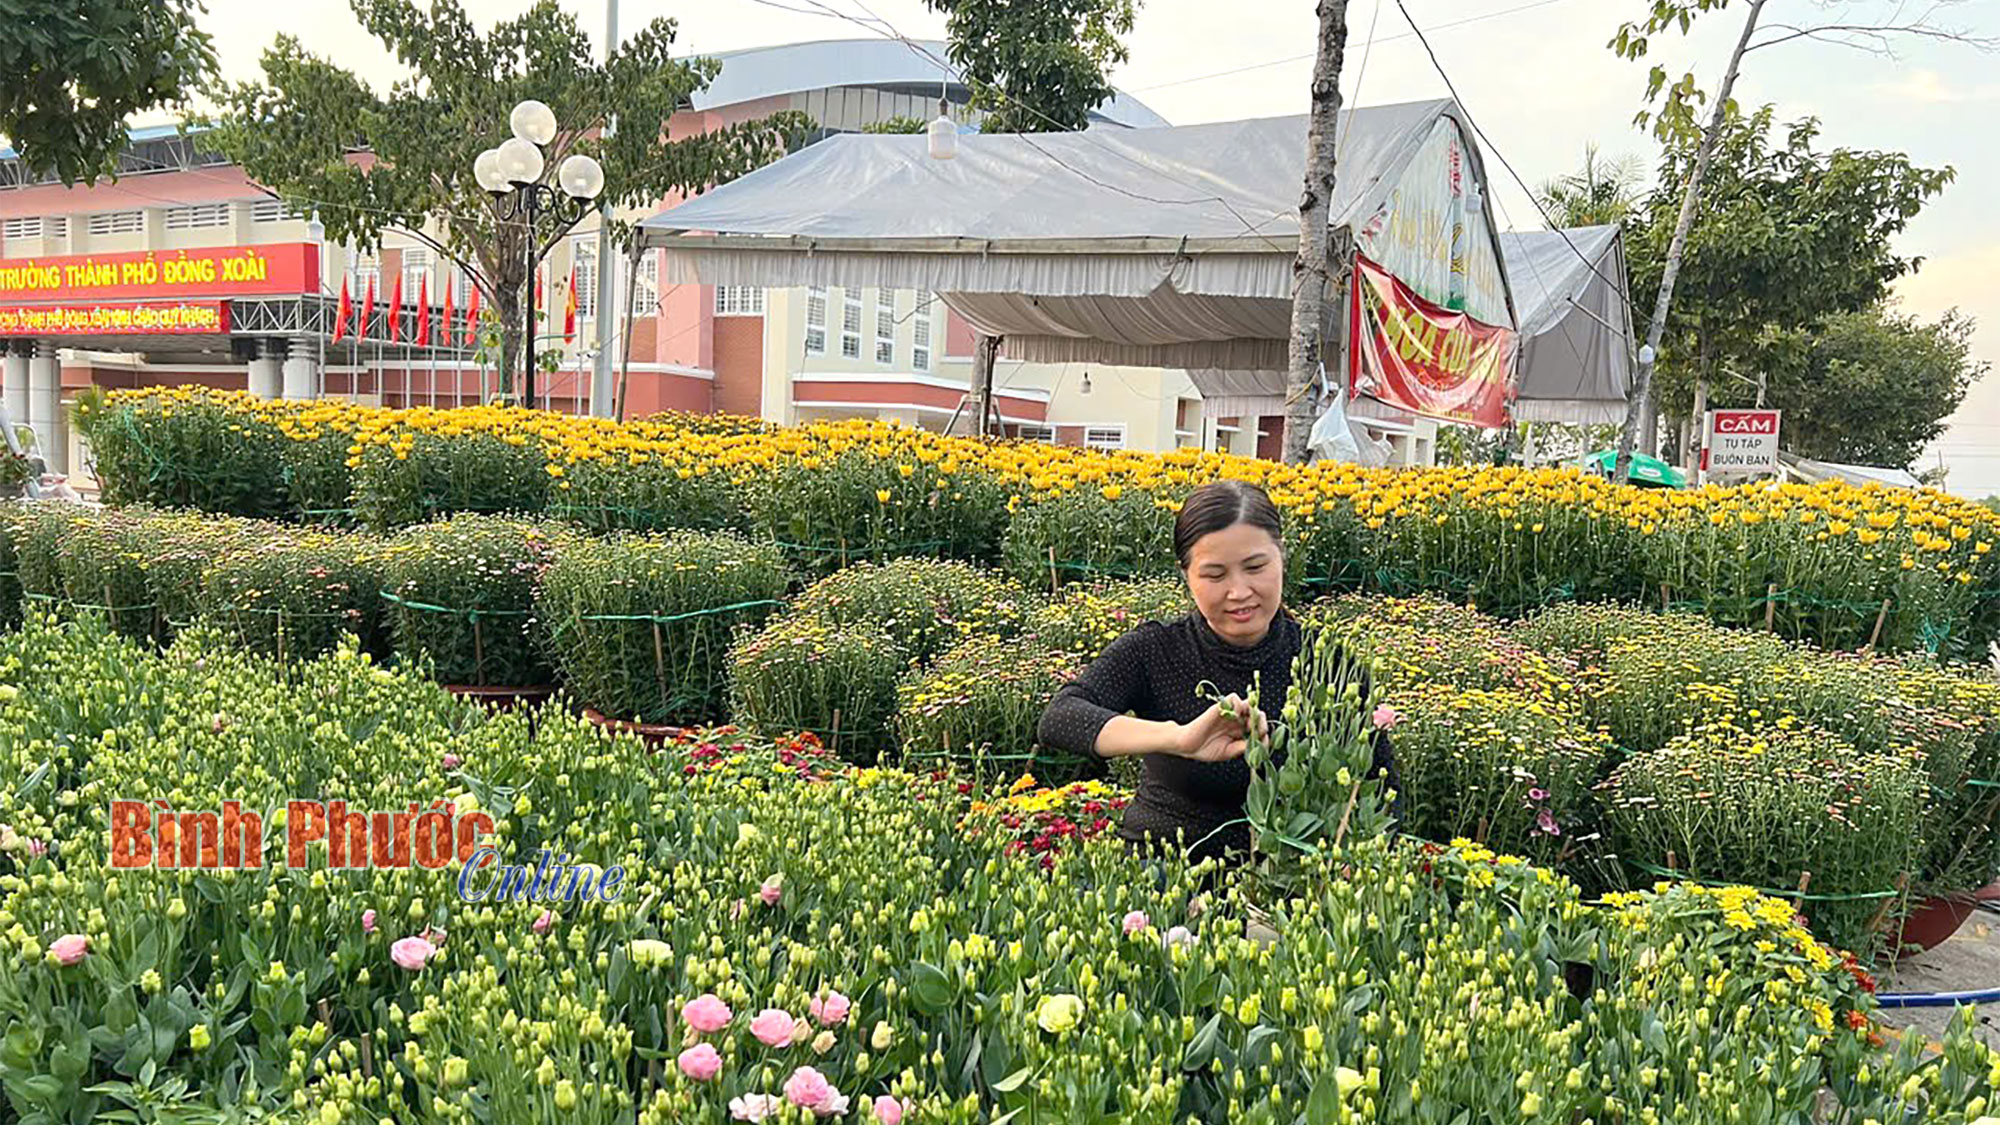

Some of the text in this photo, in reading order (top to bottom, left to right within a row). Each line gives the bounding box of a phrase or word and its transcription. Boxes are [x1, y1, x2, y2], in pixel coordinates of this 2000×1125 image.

[65, 258, 118, 287] THÀNH
[122, 251, 157, 285] PHỐ
[163, 249, 216, 284] ĐỒNG
[221, 249, 266, 281] XOÀI
[1720, 415, 1770, 432] CẤM
[1725, 438, 1738, 449] TỤ
[1714, 453, 1770, 465] BUÔN BÁN
